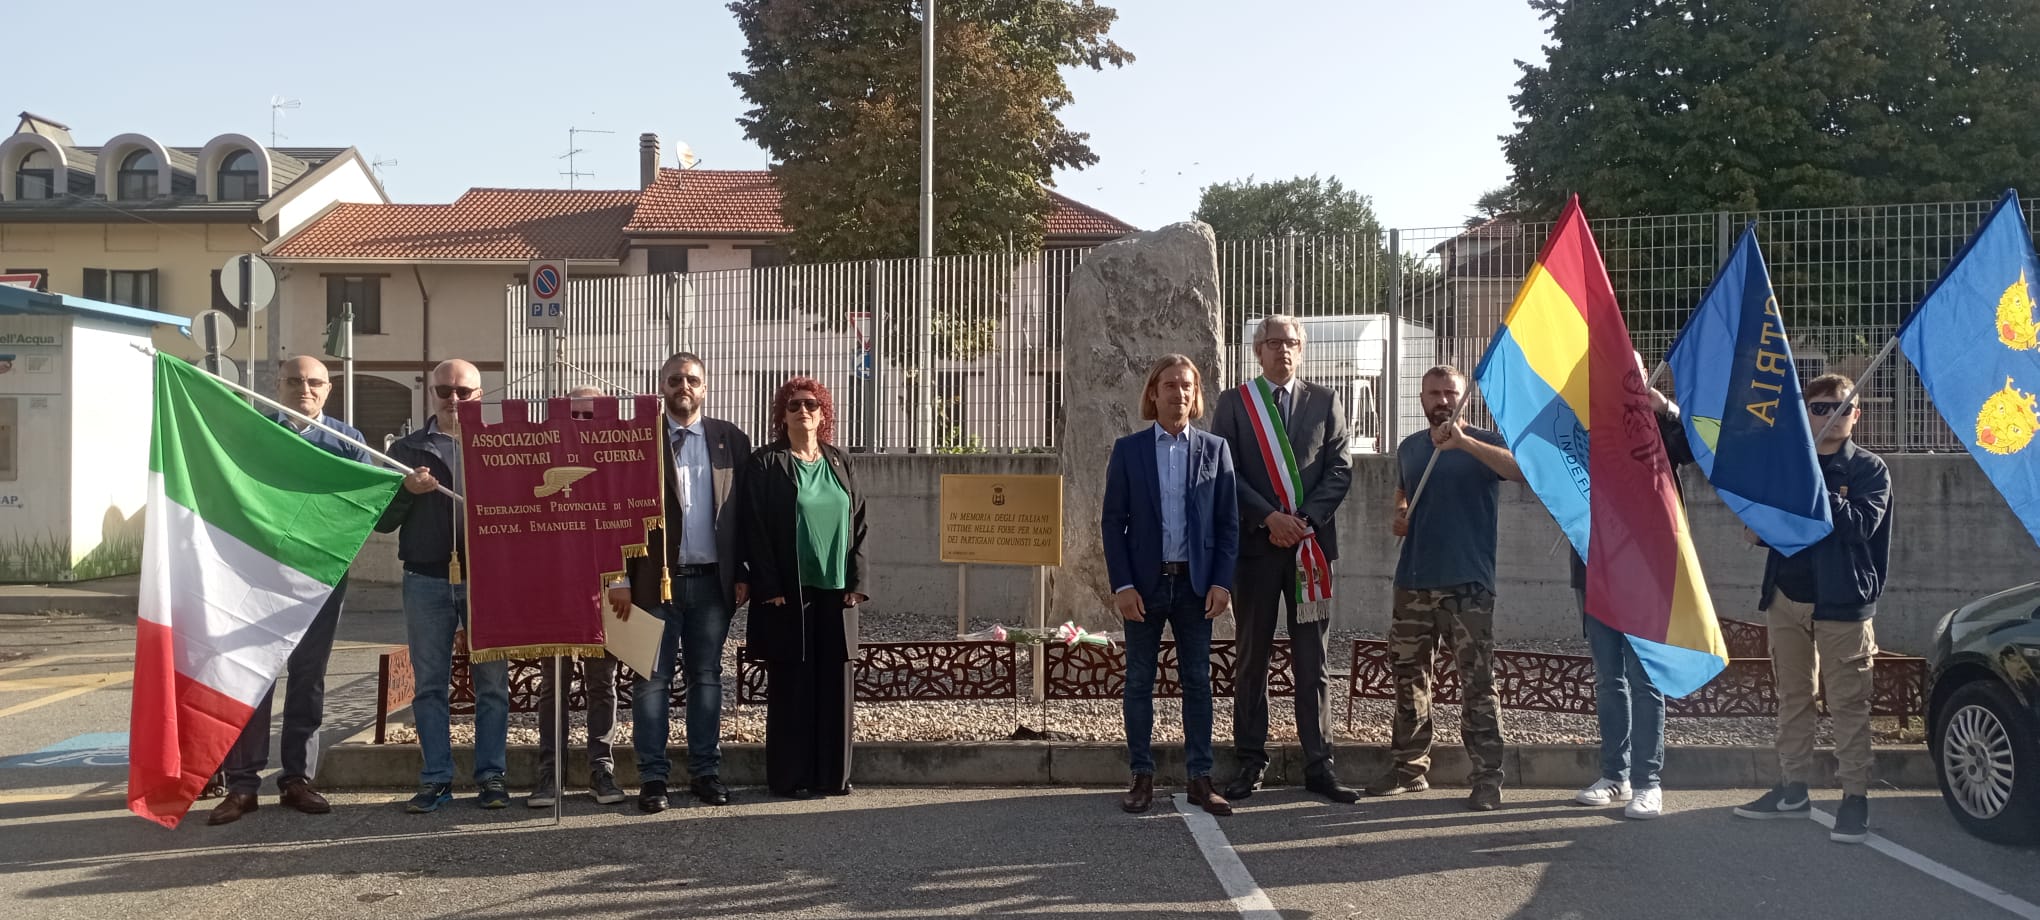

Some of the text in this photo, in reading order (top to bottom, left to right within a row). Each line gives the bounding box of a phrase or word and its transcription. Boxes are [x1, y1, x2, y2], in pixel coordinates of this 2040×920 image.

[471, 428, 653, 448] ASSOCIAZIONE NAZIONALE
[481, 449, 645, 467] VOLONTARI DI GUERRA
[0, 495, 19, 505] AP
[476, 504, 542, 516] FEDERAZIONE
[550, 501, 607, 513] PROVINCIALE
[949, 512, 1049, 523] IN MEMORIA DEGLI ITALIANI
[478, 518, 633, 536] M.O.V.M. EMANUELE LEONARDI
[947, 524, 972, 533] VITTIME
[974, 524, 995, 533] NELLE
[1017, 526, 1029, 534] PER
[1032, 526, 1053, 535] MANO
[947, 535, 1051, 547] DEI PARTIGIANI COMUNISTI SLAVI
